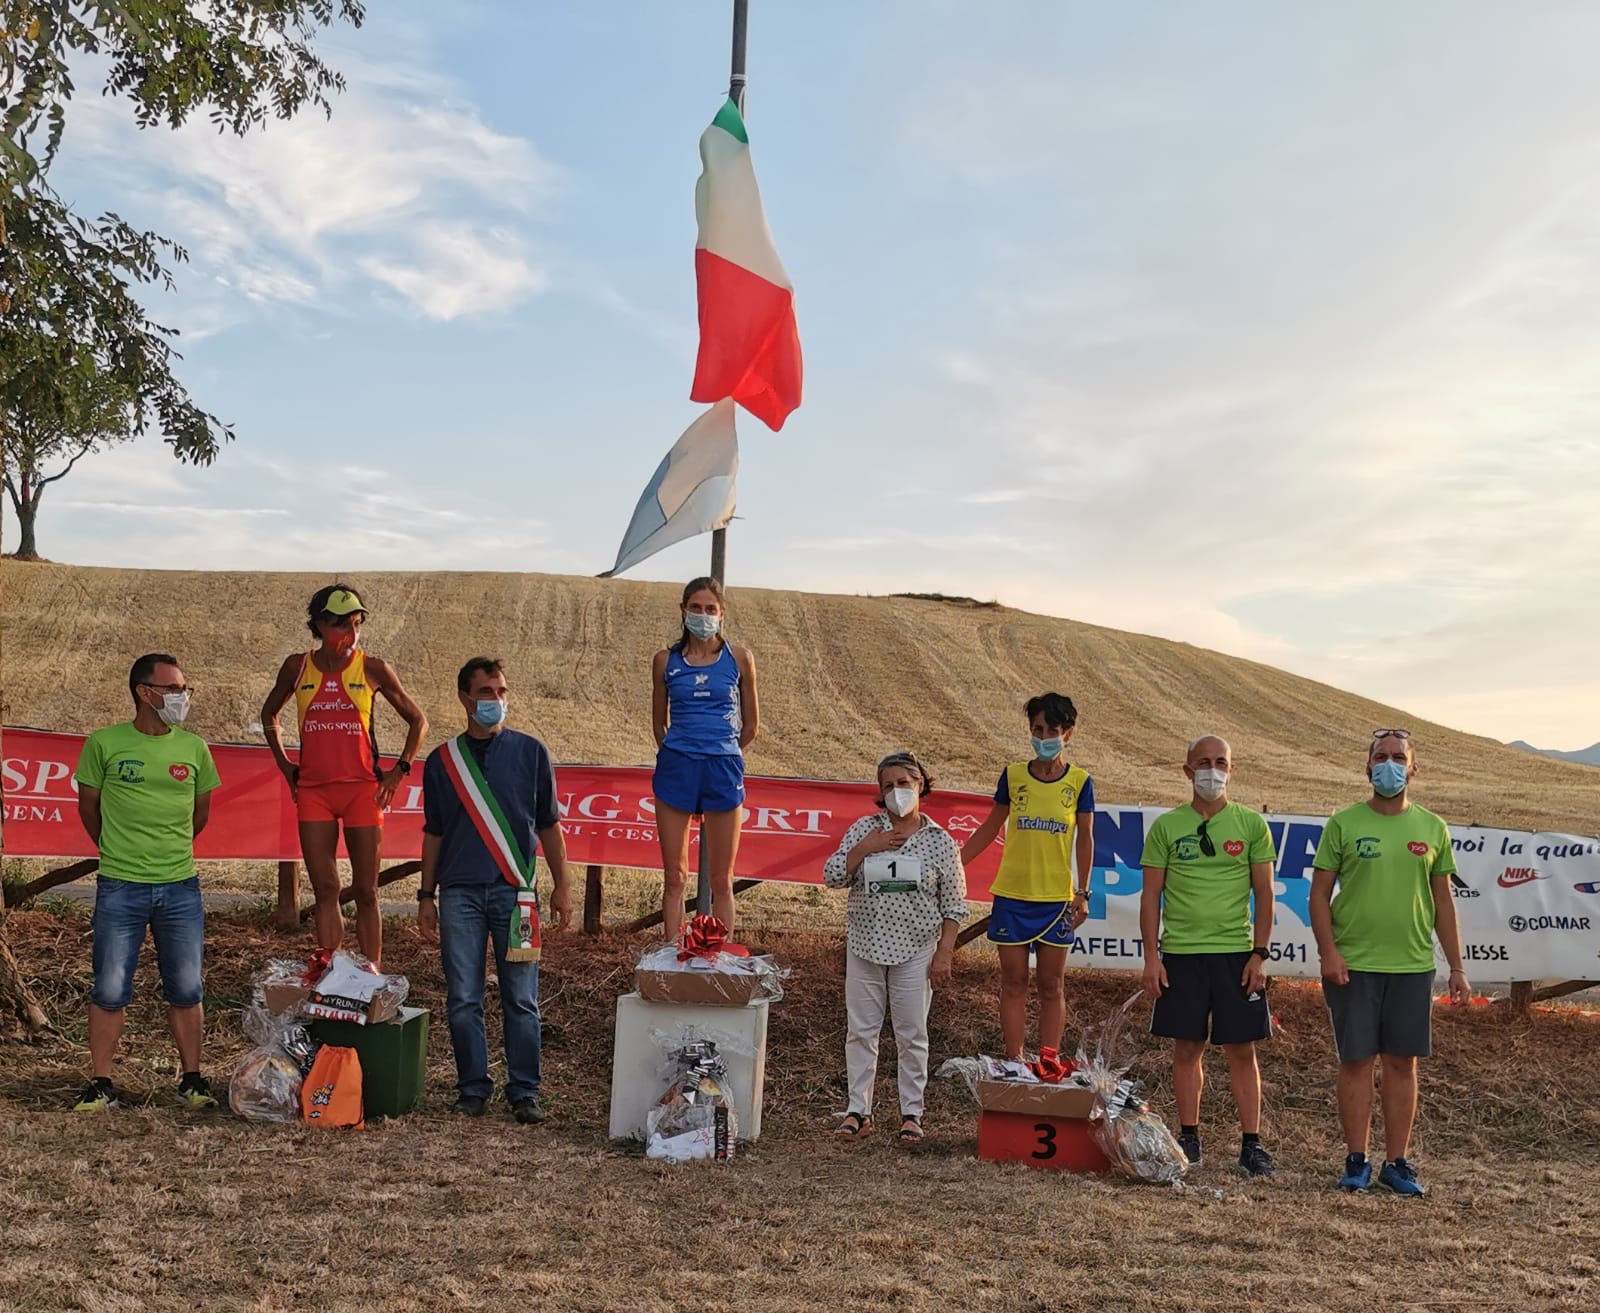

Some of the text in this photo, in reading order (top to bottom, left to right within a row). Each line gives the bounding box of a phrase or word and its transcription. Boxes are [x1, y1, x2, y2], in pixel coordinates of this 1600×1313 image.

[335, 722, 362, 732] SPORT
[1501, 837, 1523, 855] la
[887, 861, 897, 878] 1
[1505, 867, 1542, 879] NIKE
[1528, 915, 1591, 931] COLMAR
[1462, 945, 1509, 960] IESSE
[1031, 1123, 1057, 1160] 3
